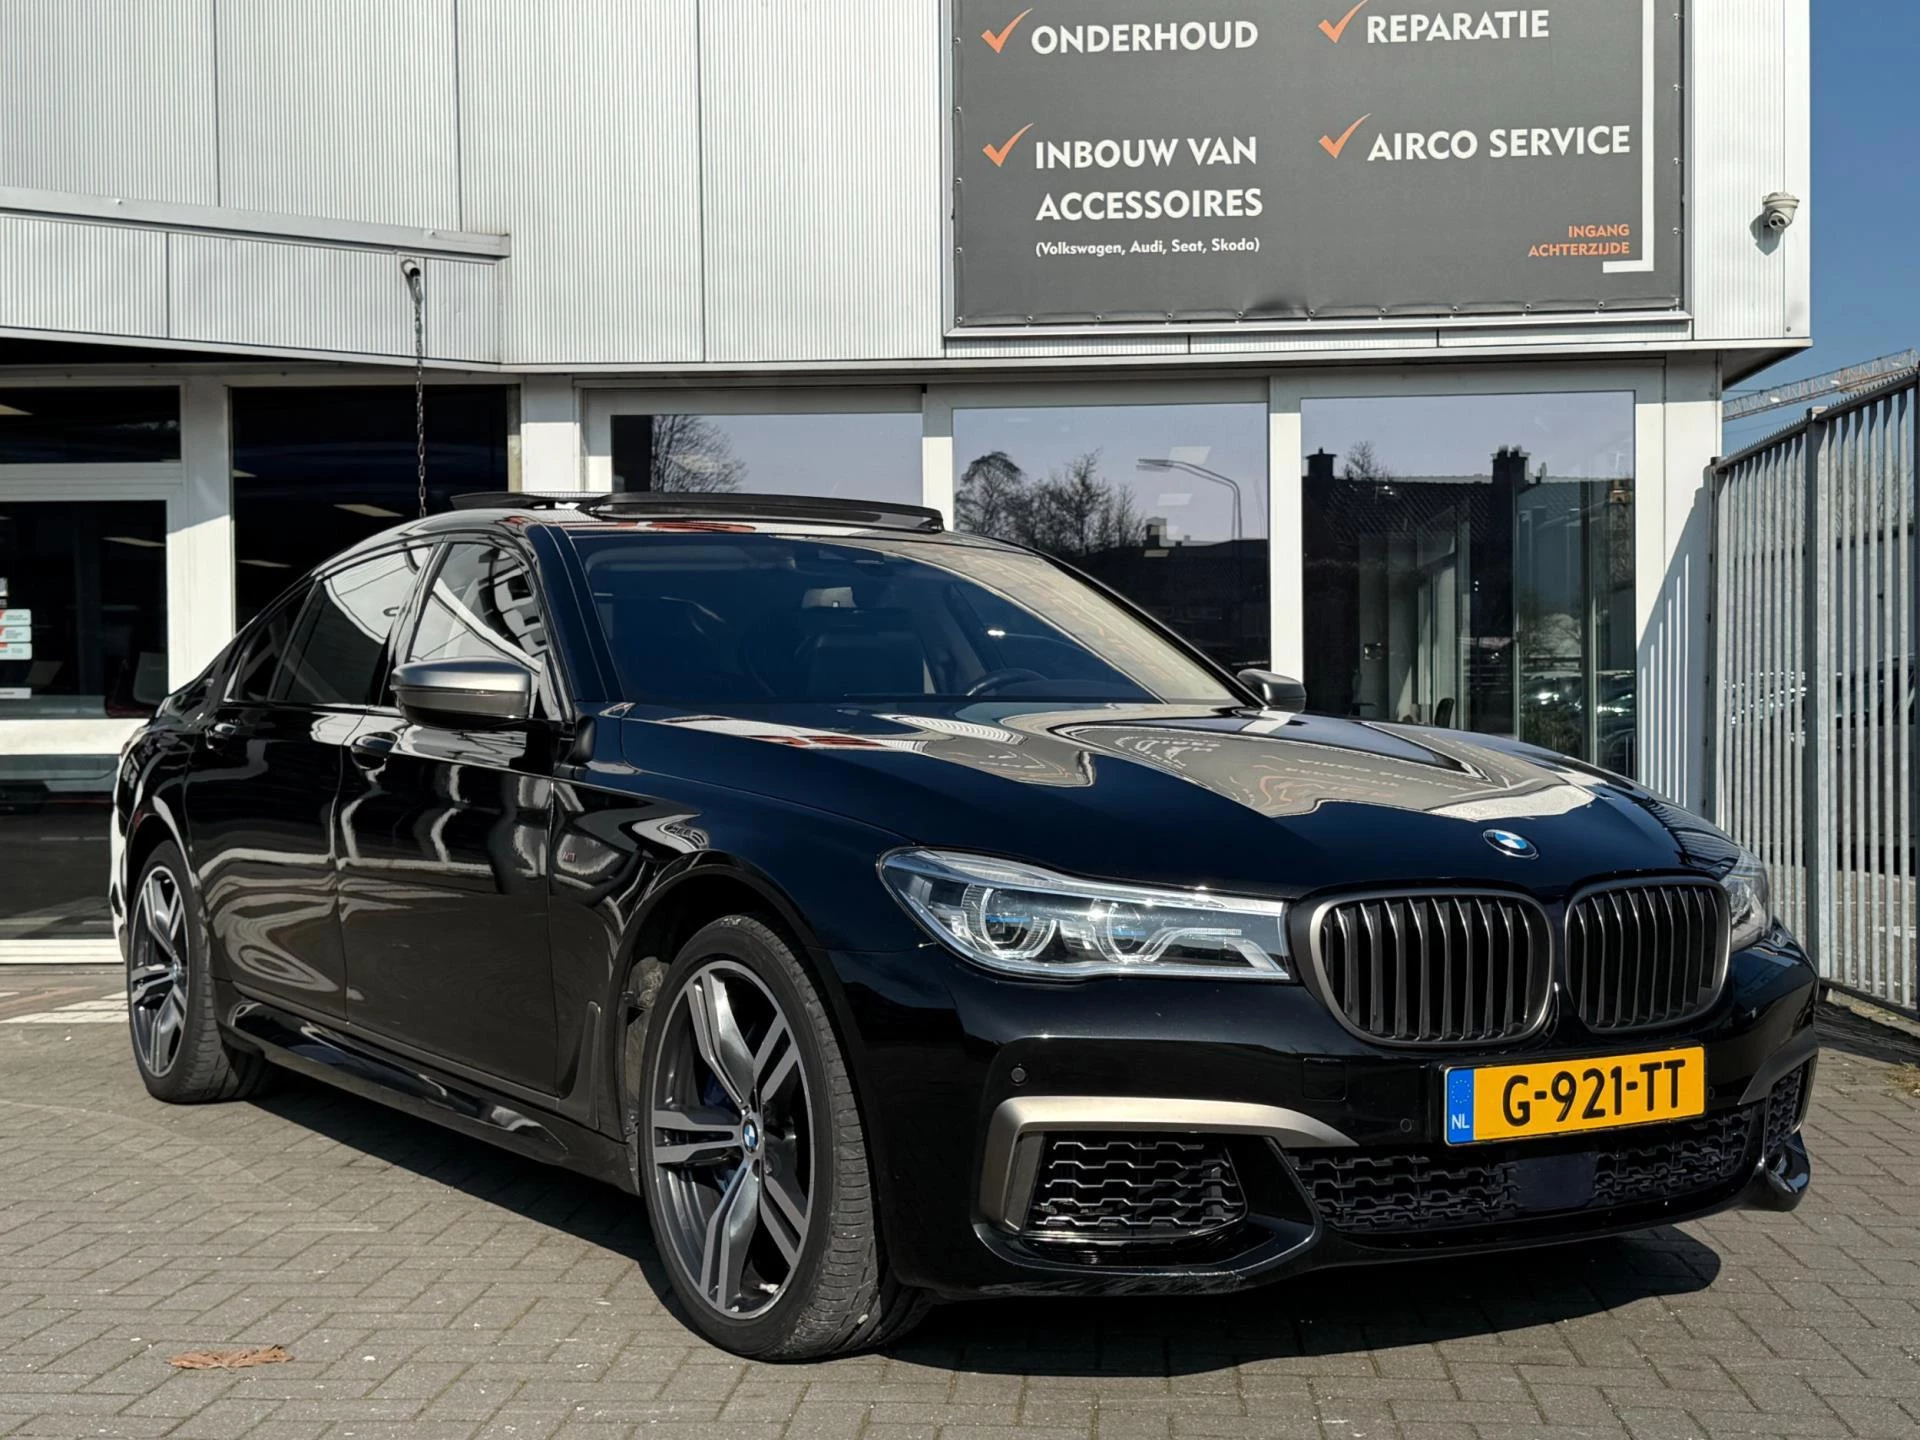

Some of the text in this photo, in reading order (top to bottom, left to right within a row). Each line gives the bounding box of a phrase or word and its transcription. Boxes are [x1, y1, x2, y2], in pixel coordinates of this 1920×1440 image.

[1031, 20, 1259, 54] ONDERHOUD
[1367, 9, 1550, 44] REPARATIE
[1035, 136, 1257, 170] INBOUW VAN
[1367, 125, 1631, 162] AIRCO SERVICE
[1035, 188, 1264, 221] ACCESSOIRES
[1035, 237, 1261, 258] (Volkswagen, Audi, Seat, Skoda)
[1568, 223, 1631, 239] INGANG
[1528, 241, 1631, 258] ACHTERZIJDE
[1502, 1058, 1686, 1127] G-921-TT
[1451, 1113, 1470, 1130] NL
